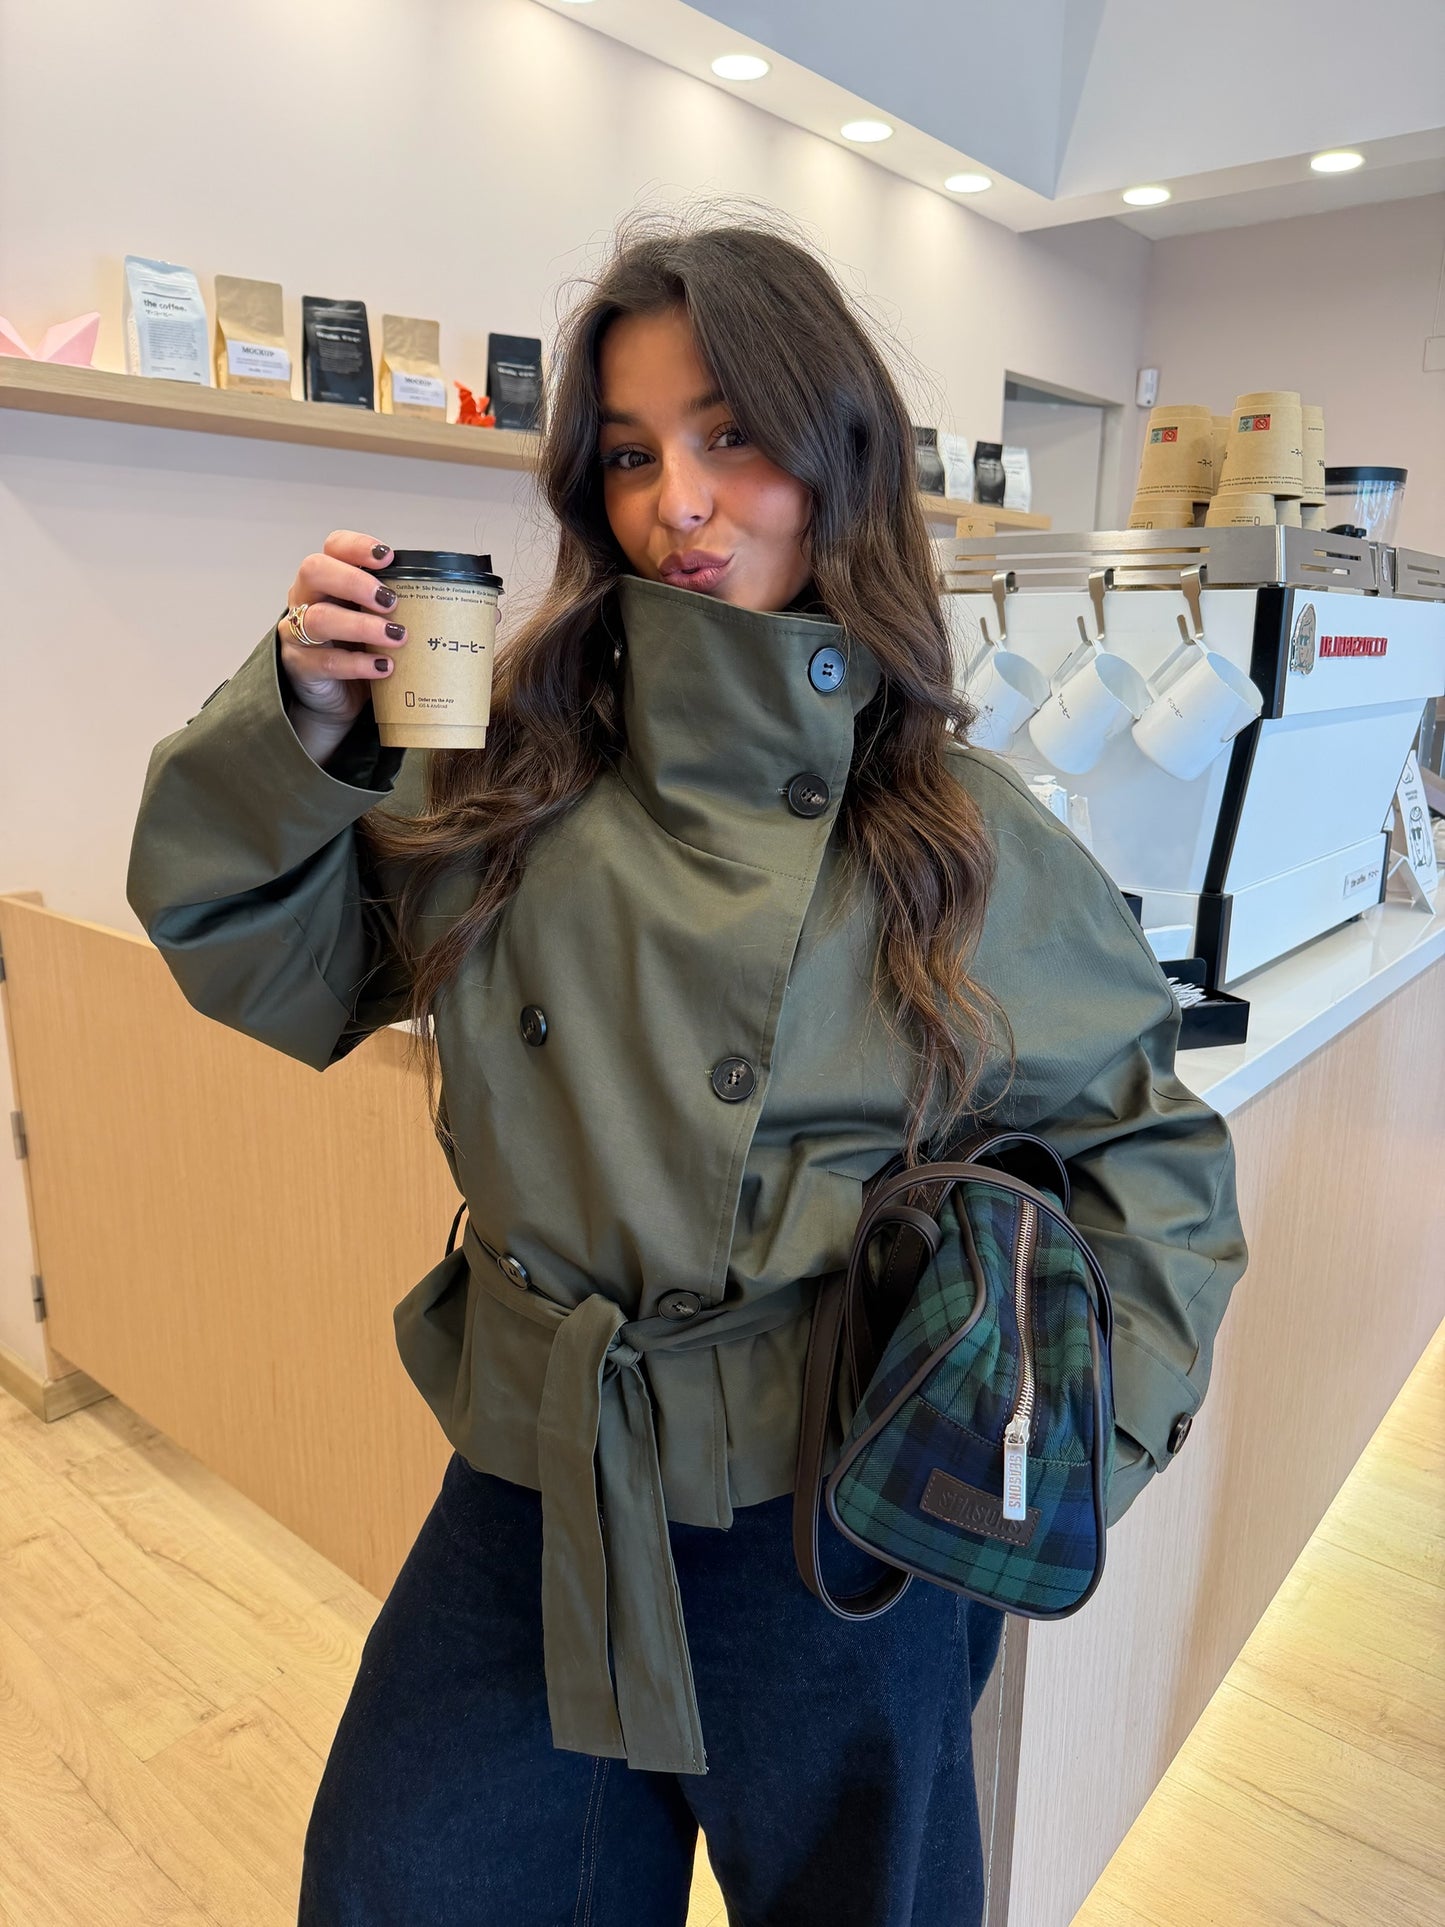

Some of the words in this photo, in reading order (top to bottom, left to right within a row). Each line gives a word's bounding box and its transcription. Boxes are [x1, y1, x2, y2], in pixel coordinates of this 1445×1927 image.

[143, 299, 158, 309] the
[427, 637, 486, 654] ザ・コーヒー
[1008, 1455, 1022, 1508] SEASONS
